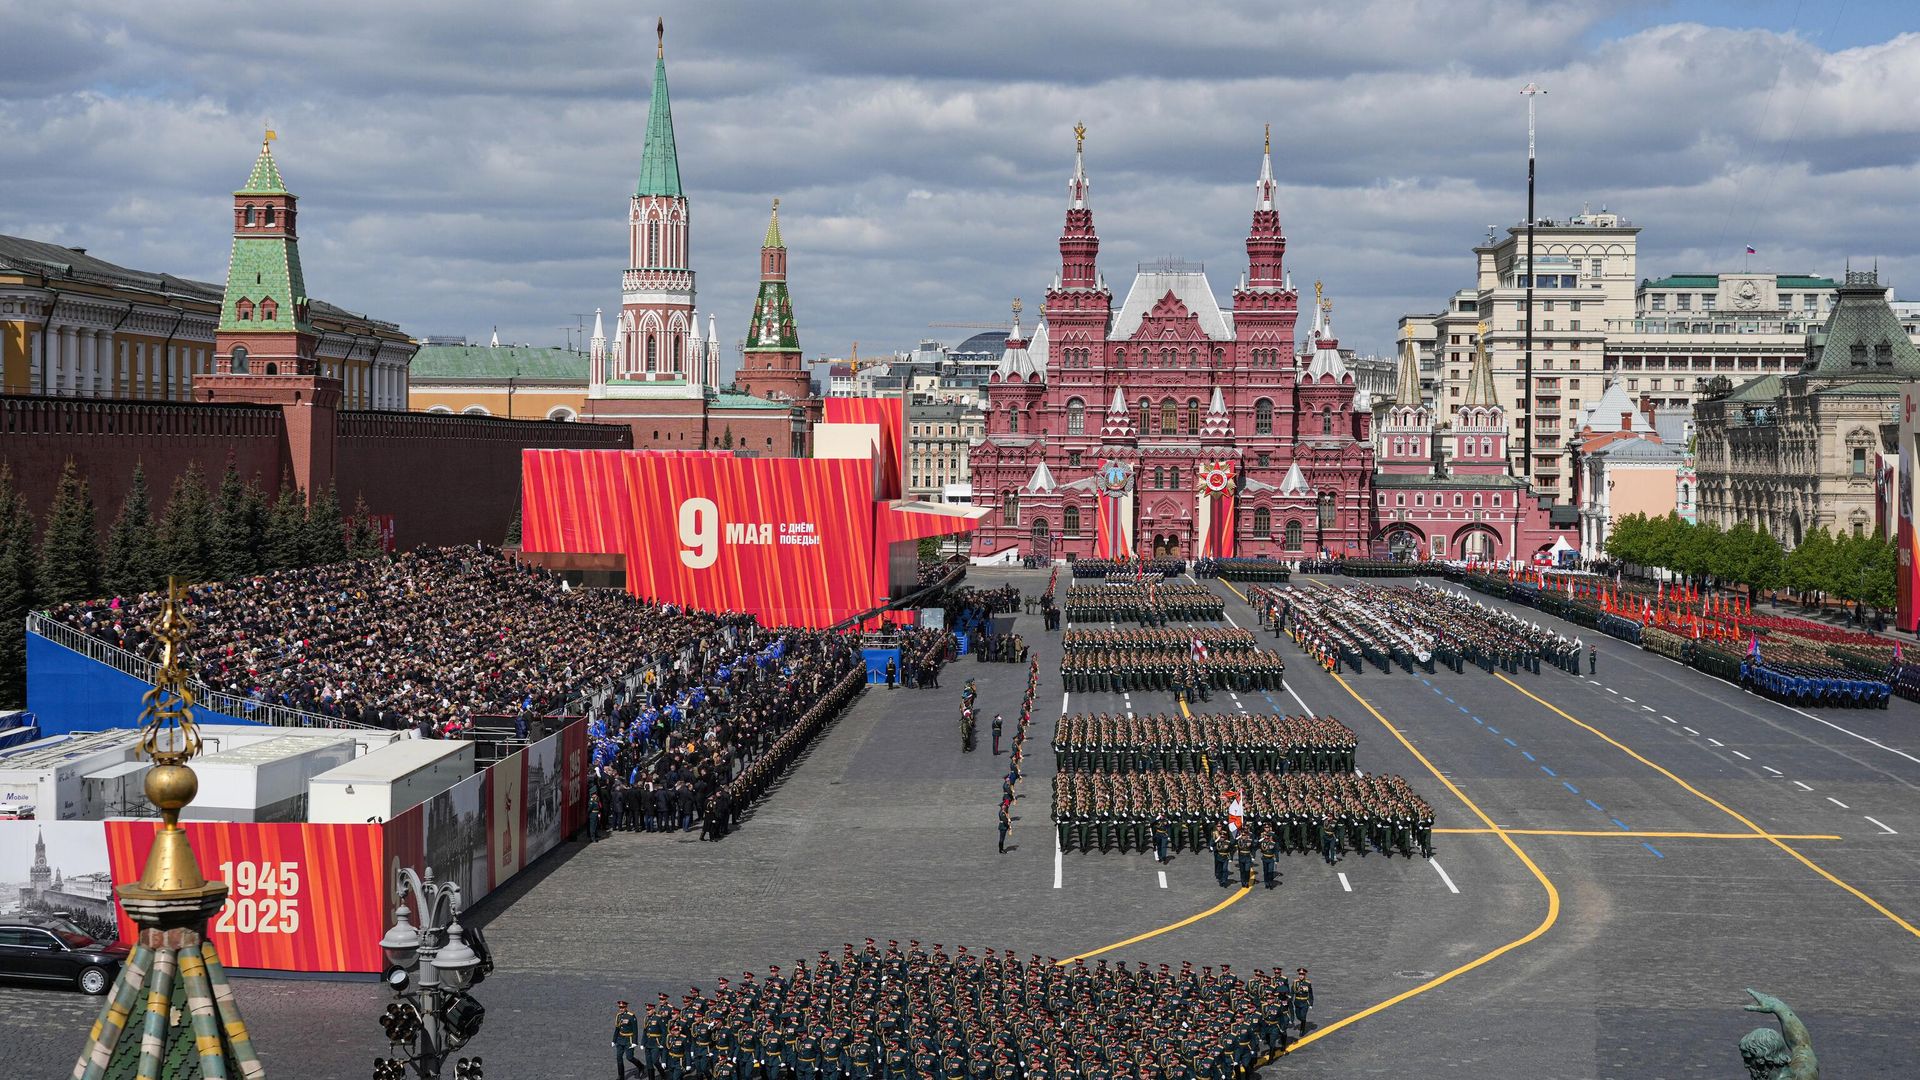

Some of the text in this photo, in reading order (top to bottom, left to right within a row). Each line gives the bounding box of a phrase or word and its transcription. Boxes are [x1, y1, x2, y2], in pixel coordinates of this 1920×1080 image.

[679, 497, 773, 569] 9 МАЯ
[780, 522, 814, 534] С ДНЁМ
[780, 535, 820, 546] ПОБЕДЫ!
[6, 792, 29, 801] Mobile
[219, 861, 299, 896] 1945
[215, 898, 299, 934] 2025
